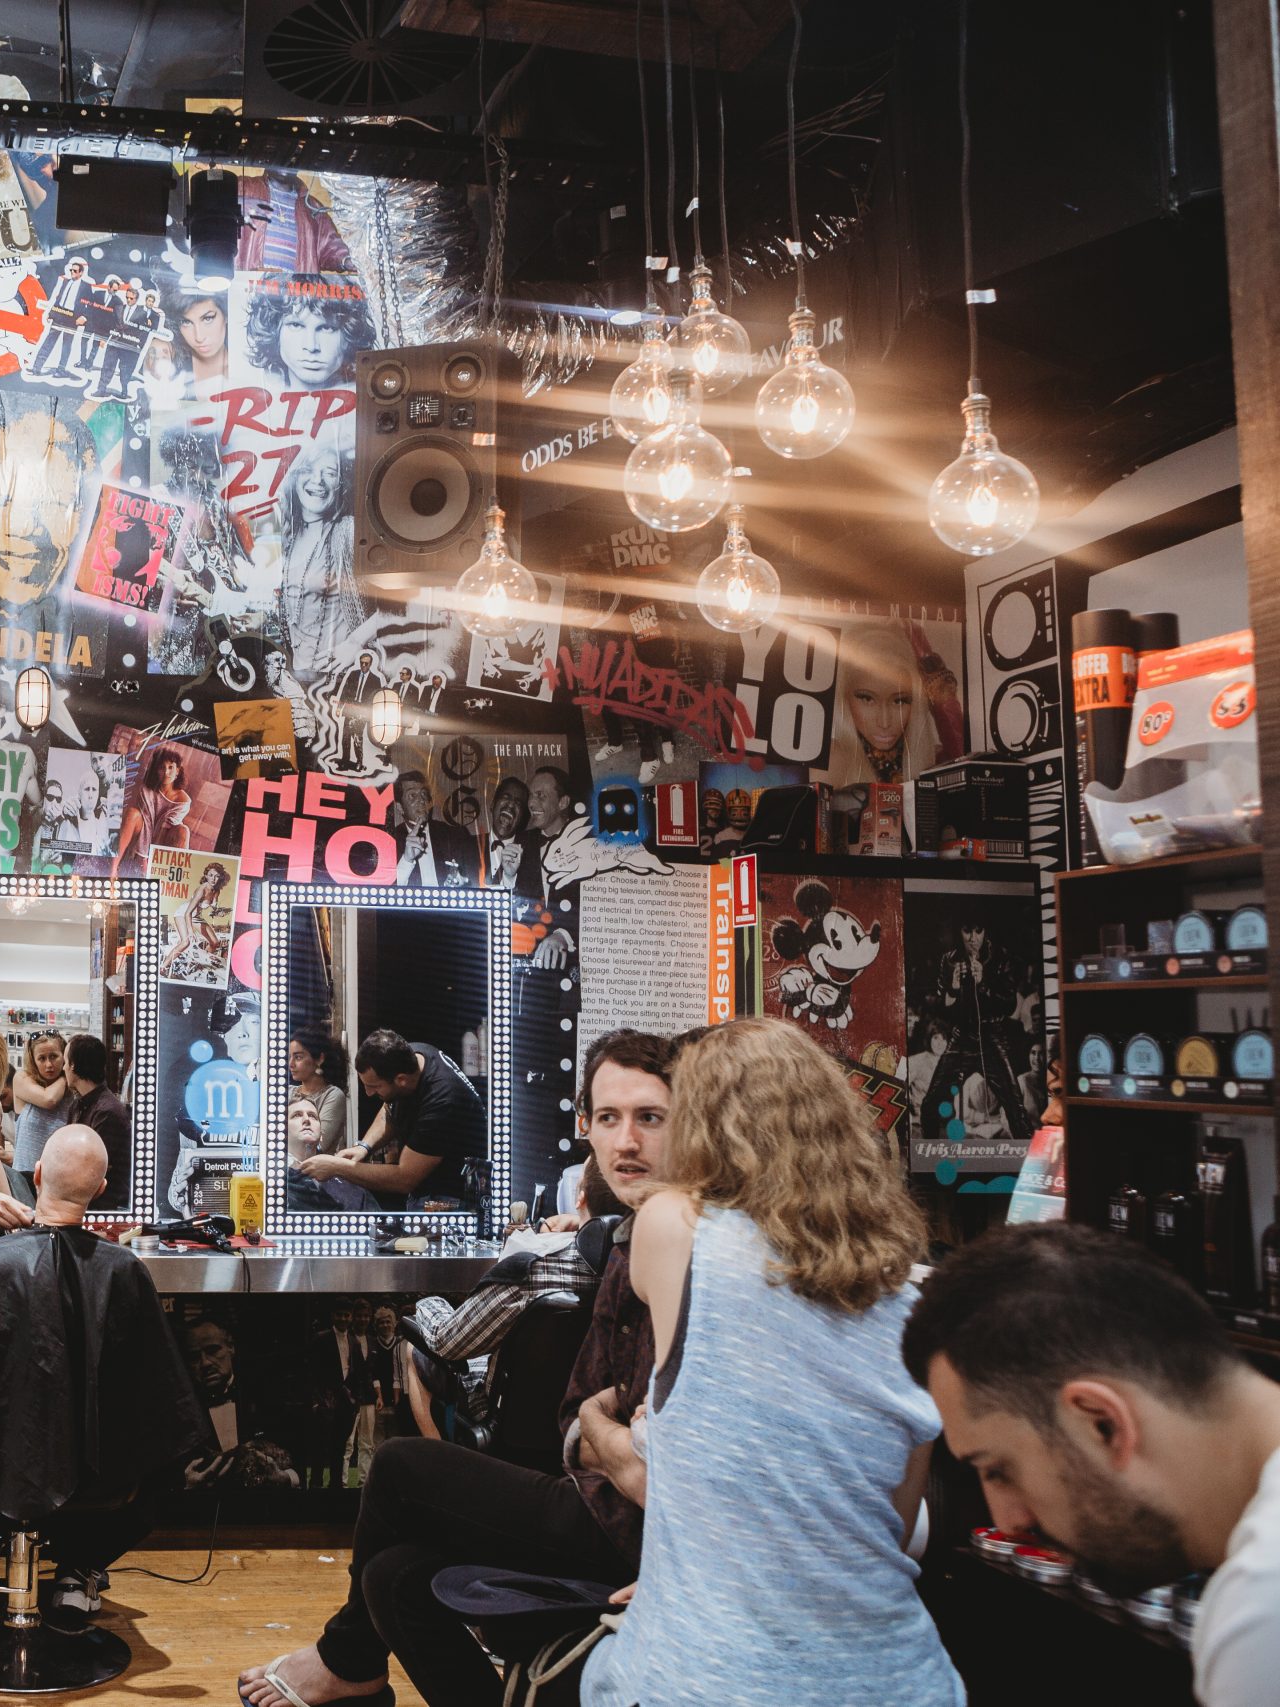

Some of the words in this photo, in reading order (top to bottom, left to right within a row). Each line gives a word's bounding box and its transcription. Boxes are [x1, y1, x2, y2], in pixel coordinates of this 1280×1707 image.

[210, 386, 357, 447] RIP
[521, 433, 574, 474] ODDS
[577, 421, 599, 450] BE
[220, 445, 303, 501] 27
[107, 490, 176, 526] FIGHT
[611, 544, 671, 569] DMC
[92, 573, 149, 607] ISMS!
[628, 604, 658, 622] RUN
[889, 603, 959, 623] MINAJ
[632, 614, 660, 633] DMC
[738, 620, 838, 693] YO
[731, 682, 826, 762] LO
[221, 747, 232, 755] art
[233, 746, 240, 754] is
[241, 745, 260, 753] what
[261, 744, 276, 754] you
[276, 743, 291, 751] can
[239, 753, 252, 763] get
[252, 752, 273, 761] away
[274, 749, 292, 758] with.
[494, 744, 511, 757] THE
[515, 744, 533, 757] RAT
[537, 744, 562, 757] PACK
[246, 771, 396, 826] HEY
[661, 834, 694, 843] EXTINGUISHER
[672, 828, 684, 836] FIRE
[240, 811, 398, 886] HO
[152, 848, 193, 868] ATTACK
[151, 867, 158, 875] OF
[158, 868, 168, 877] THE
[168, 866, 184, 882] 50
[582, 885, 607, 893] fucking
[608, 886, 618, 895] big
[681, 891, 707, 899] washing
[638, 899, 666, 907] compact
[683, 901, 707, 909] players
[680, 910, 707, 918] Choose
[633, 948, 660, 956] Choose
[613, 958, 655, 966] leisurewear
[674, 961, 706, 969] matching
[915, 1142, 949, 1158] Elvis
[950, 1142, 996, 1156] Aaron
[205, 1162, 229, 1171] Detroit
